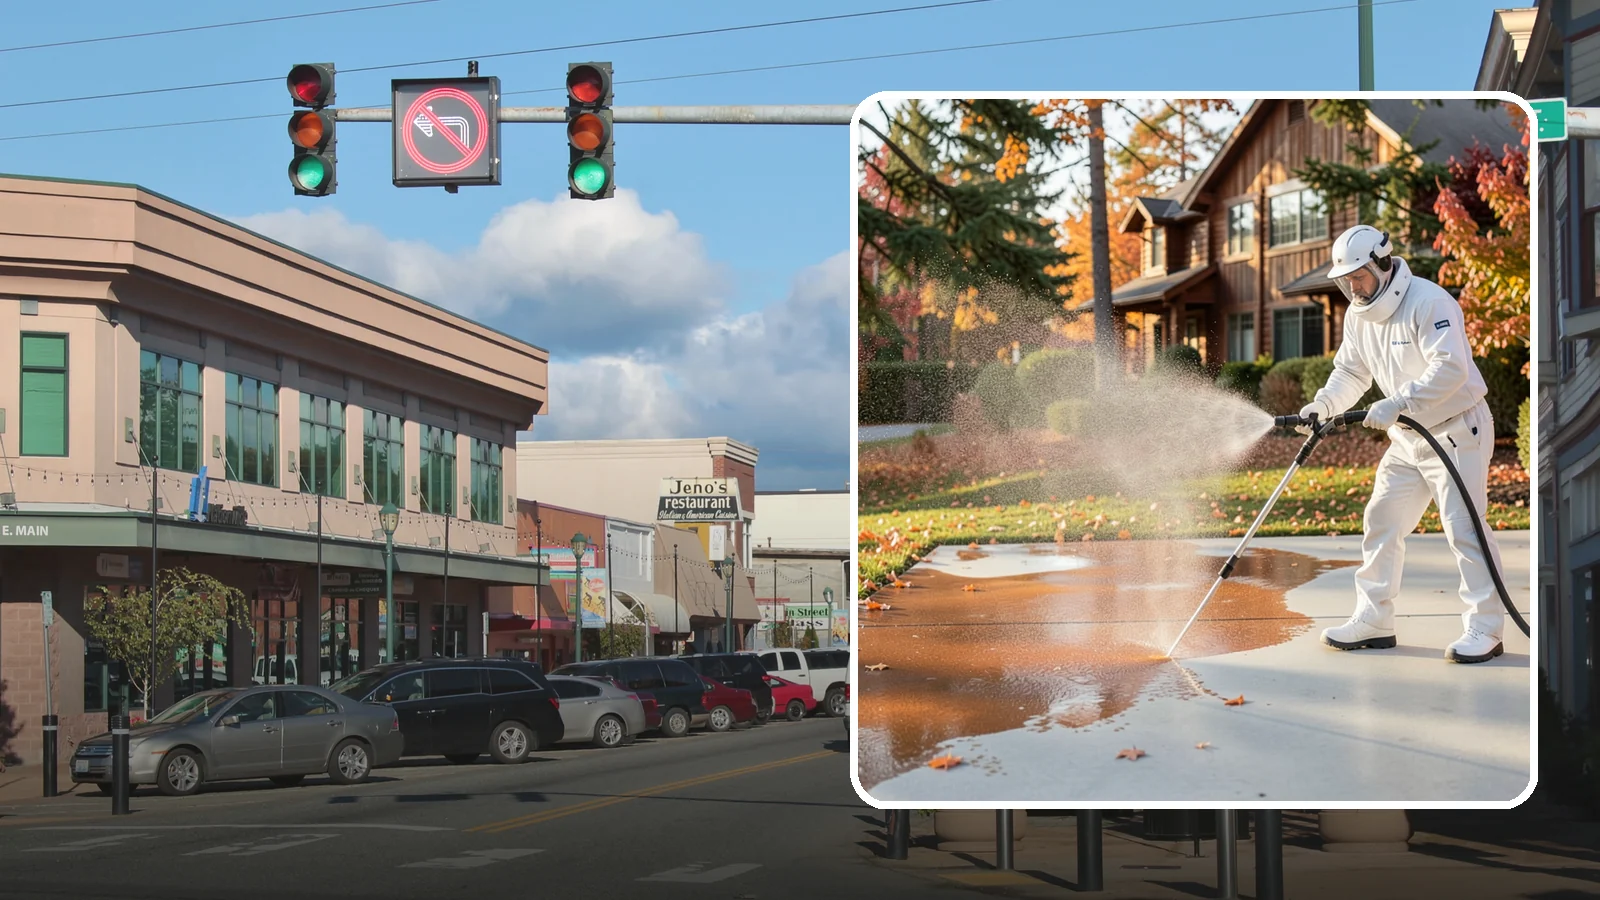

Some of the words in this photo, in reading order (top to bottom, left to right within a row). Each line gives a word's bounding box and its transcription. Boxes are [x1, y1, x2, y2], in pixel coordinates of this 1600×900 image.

[670, 480, 727, 494] Jeno's
[665, 496, 731, 509] restaurant
[658, 510, 682, 520] Italian
[686, 510, 714, 520] American
[714, 509, 737, 519] Cuisine
[2, 526, 12, 536] E.
[16, 526, 48, 536] MAIN
[797, 608, 828, 616] Street
